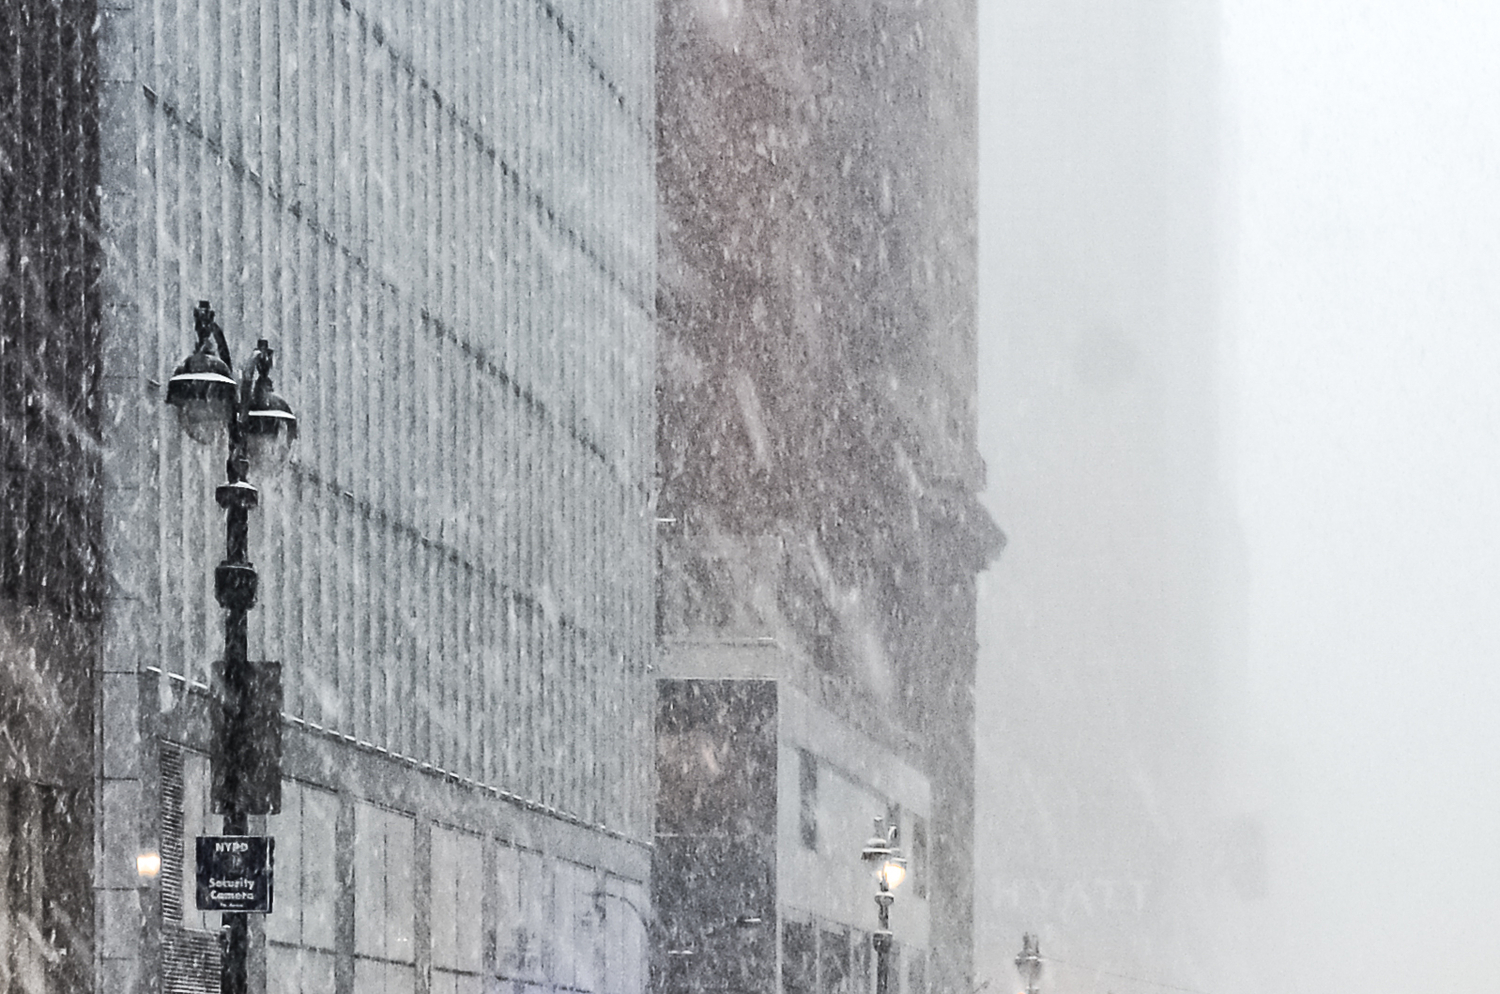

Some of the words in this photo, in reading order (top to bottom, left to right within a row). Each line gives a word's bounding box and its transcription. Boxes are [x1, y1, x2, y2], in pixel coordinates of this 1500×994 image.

[215, 842, 249, 852] NYPD
[208, 877, 255, 890] Security
[210, 889, 254, 900] Camera
[992, 877, 1152, 922] HYATT
